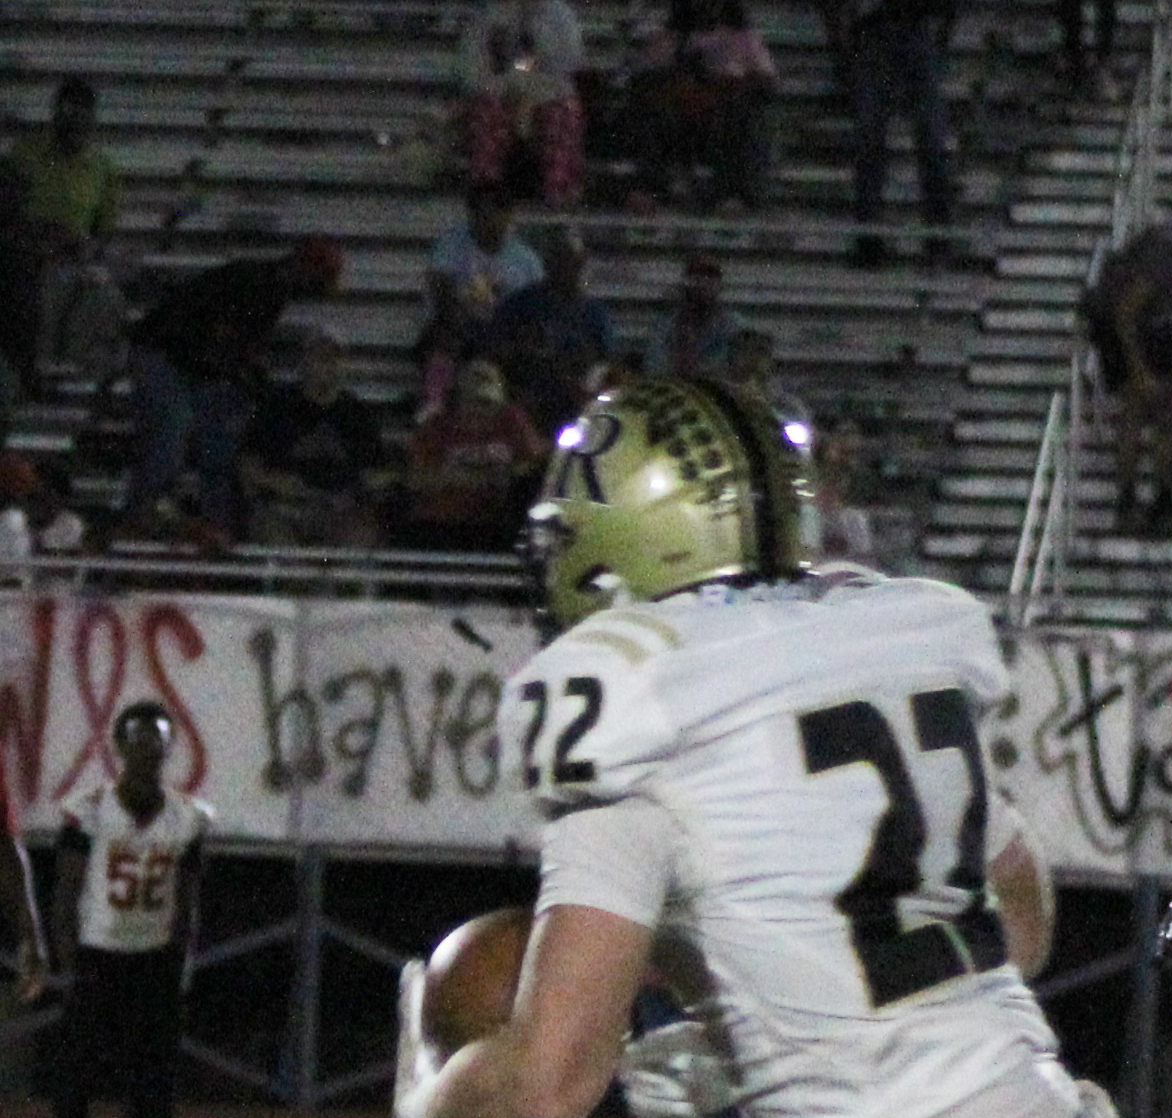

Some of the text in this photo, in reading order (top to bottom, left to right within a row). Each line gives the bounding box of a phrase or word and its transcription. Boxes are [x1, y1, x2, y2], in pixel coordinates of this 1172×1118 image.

[556, 412, 624, 505] R
[106, 842, 175, 912] 52
[798, 687, 1009, 1009] 22
